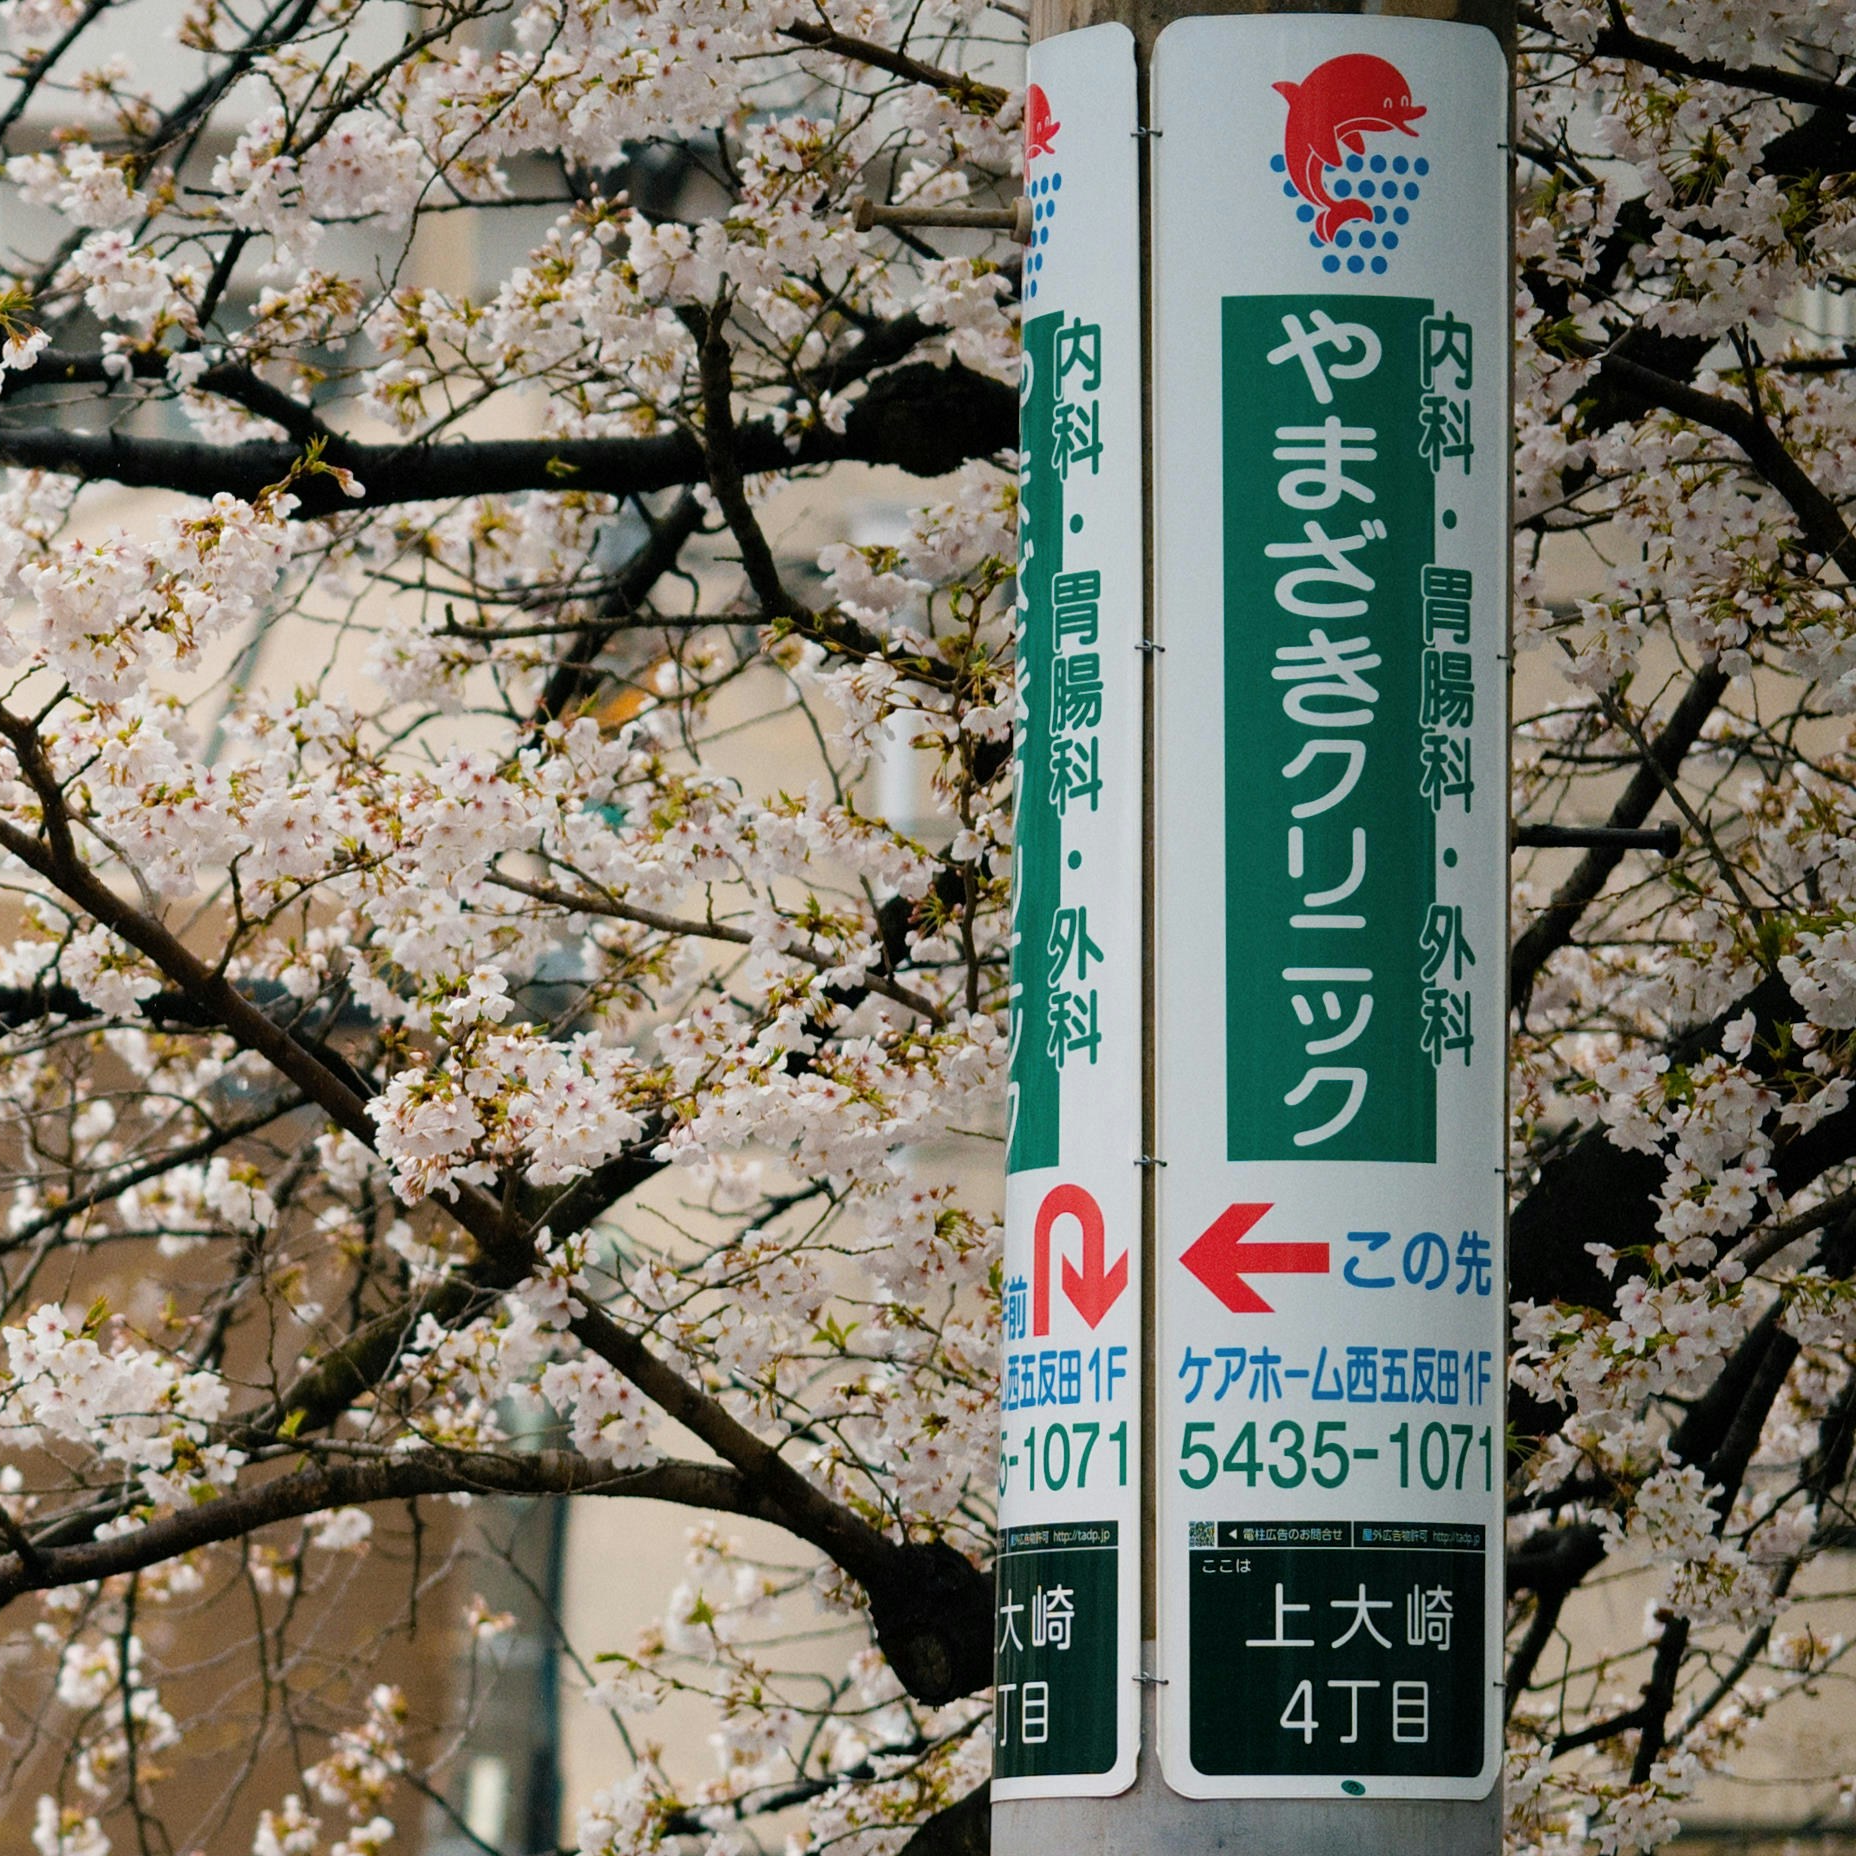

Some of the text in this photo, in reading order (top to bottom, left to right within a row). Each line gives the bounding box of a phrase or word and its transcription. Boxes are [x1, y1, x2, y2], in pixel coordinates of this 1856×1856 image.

[1049, 317, 1104, 1065] 内科・胃腸科・外科
[1420, 311, 1476, 1067] 内科・胃腸科・外科
[1264, 309, 1387, 1146] やまざきクリニック
[1343, 1230, 1492, 1296] この先
[1178, 1346, 1492, 1406] ケアホーム西五反田1F
[1179, 1420, 1492, 1492] 5435-1071
[1202, 1559, 1252, 1574] ここは
[1243, 1528, 1343, 1541] 電柱広告のお問合せ
[996, 1583, 1075, 1655] 大崎
[1245, 1582, 1454, 1650] 上大崎
[996, 1681, 1049, 1747] 丁目
[1280, 1678, 1429, 1744] 4丁目
